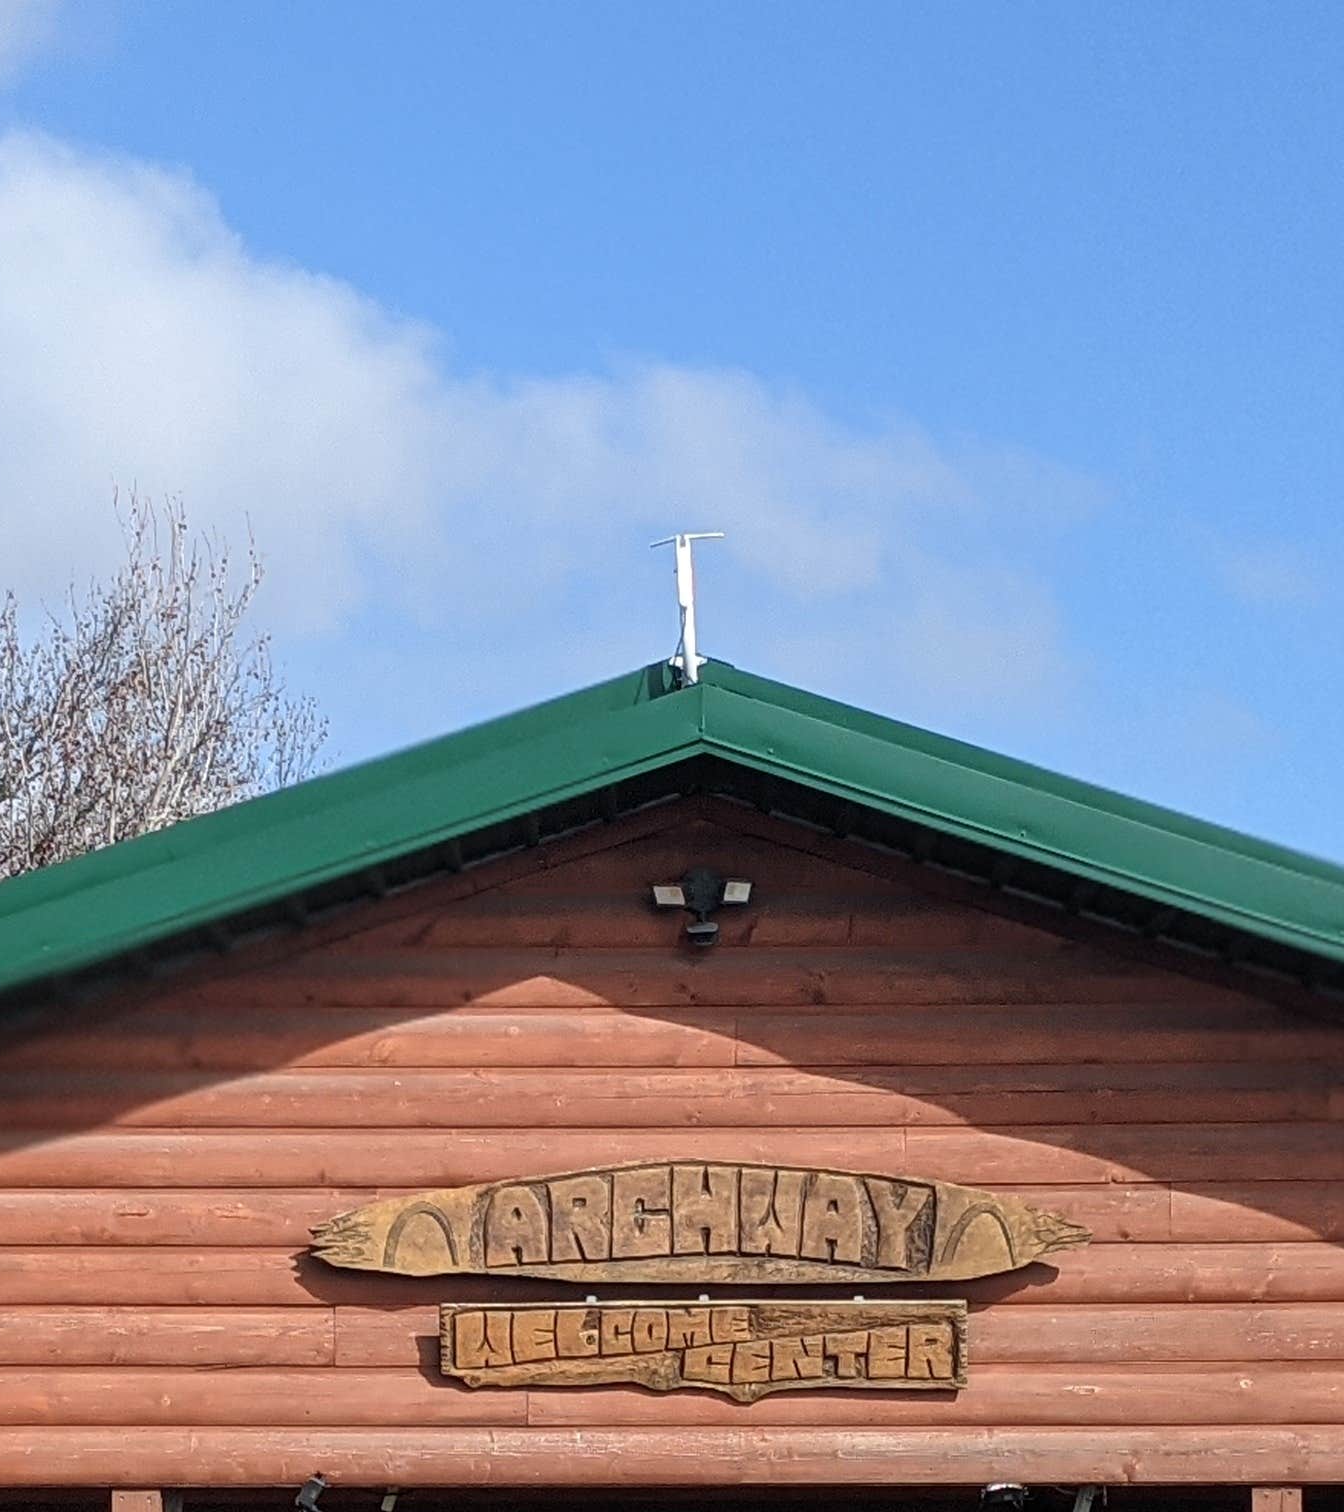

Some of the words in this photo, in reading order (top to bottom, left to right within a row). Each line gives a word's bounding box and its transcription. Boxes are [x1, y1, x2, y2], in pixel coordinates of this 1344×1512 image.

[484, 1164, 937, 1272] ARCHWAY
[455, 1306, 752, 1370] WELCOME
[681, 1323, 955, 1386] CENTER
